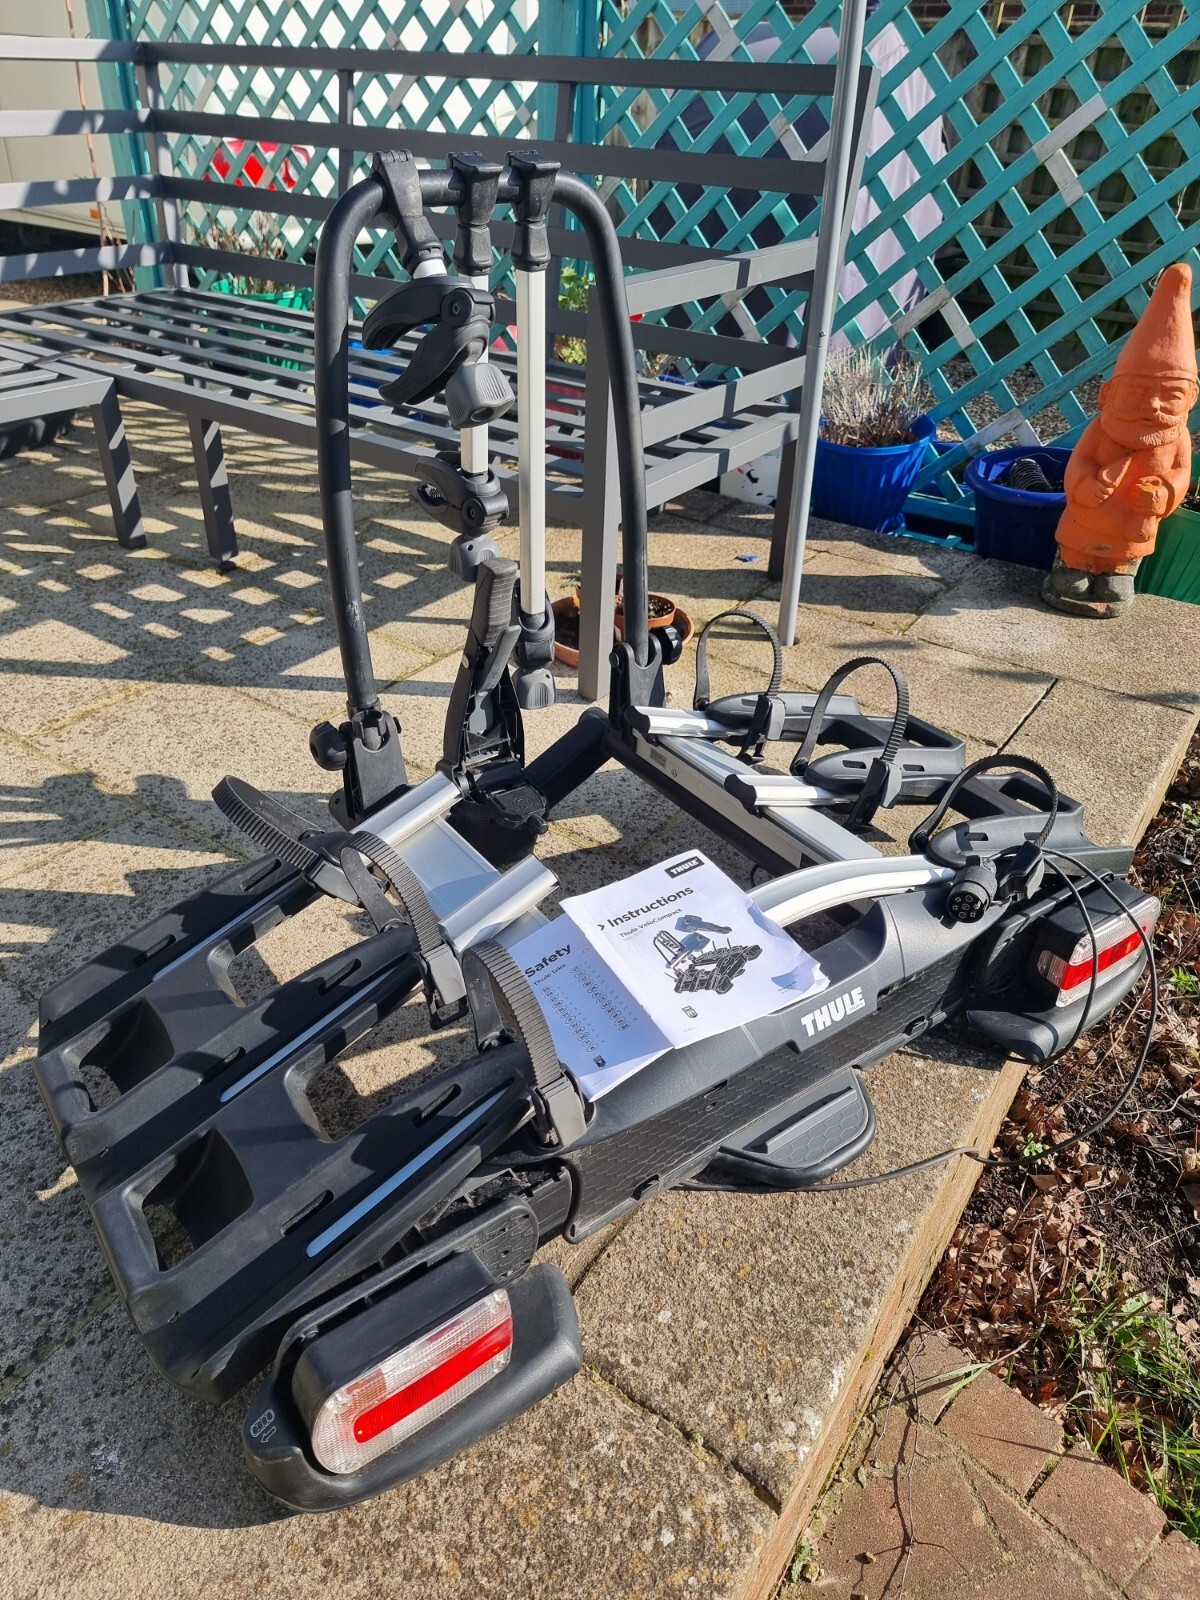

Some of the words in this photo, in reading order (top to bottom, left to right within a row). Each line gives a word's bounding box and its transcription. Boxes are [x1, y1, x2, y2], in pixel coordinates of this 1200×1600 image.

[669, 858, 698, 876] THULE
[607, 886, 694, 928] Instructions
[619, 927, 638, 938] Thule
[638, 908, 683, 929] VeloCompact
[524, 944, 571, 978] Safety
[533, 972, 551, 986] Thule
[551, 963, 566, 975] bike
[800, 986, 866, 1037] THULE
